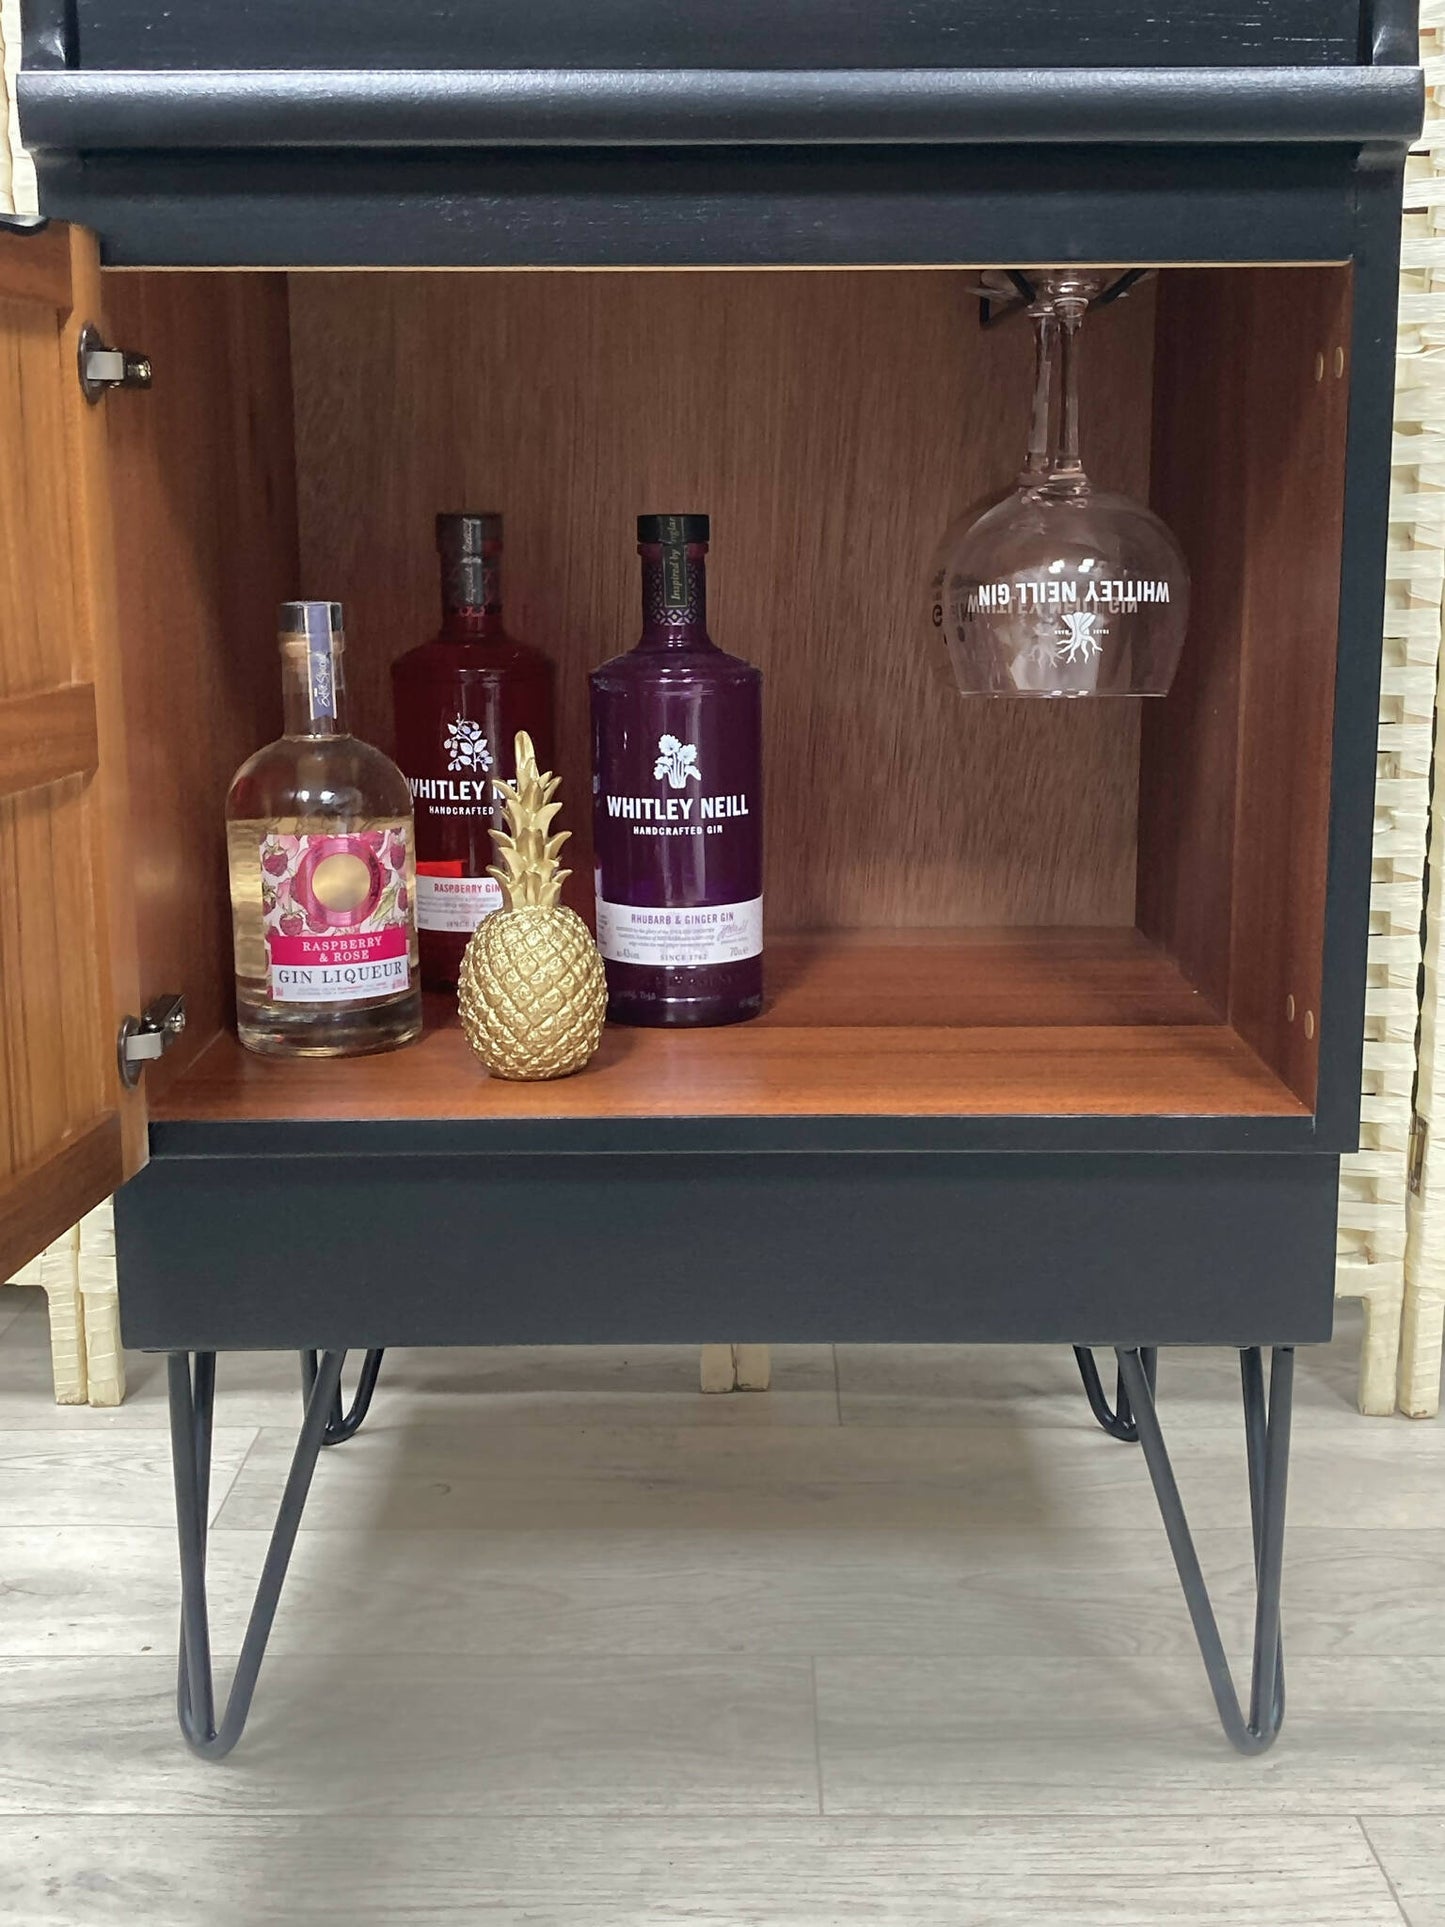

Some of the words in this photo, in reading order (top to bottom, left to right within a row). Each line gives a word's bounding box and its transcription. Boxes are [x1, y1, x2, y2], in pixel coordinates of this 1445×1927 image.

[978, 583, 1010, 606] GIN
[1016, 580, 1077, 604] NEILL
[1085, 580, 1170, 603] WHITLEY
[408, 777, 485, 800] WHITLEY
[429, 806, 494, 816] HANDCRAFTED
[606, 795, 694, 820] WHITLEY
[700, 794, 749, 819] NEILL
[633, 825, 703, 836] HANDCRAFTED
[706, 825, 723, 835] GIN
[434, 883, 482, 893] RASPBERRY
[485, 884, 500, 893] GIN
[631, 913, 671, 925] RHUBARB
[675, 916, 682, 925] &
[685, 913, 718, 925] GINGER
[720, 911, 734, 922] GIN
[302, 935, 383, 952] RASPBERRY
[319, 954, 328, 963] &
[333, 949, 370, 962] ROSE
[278, 969, 313, 984] GIN
[322, 961, 403, 985] LIQUEUR
